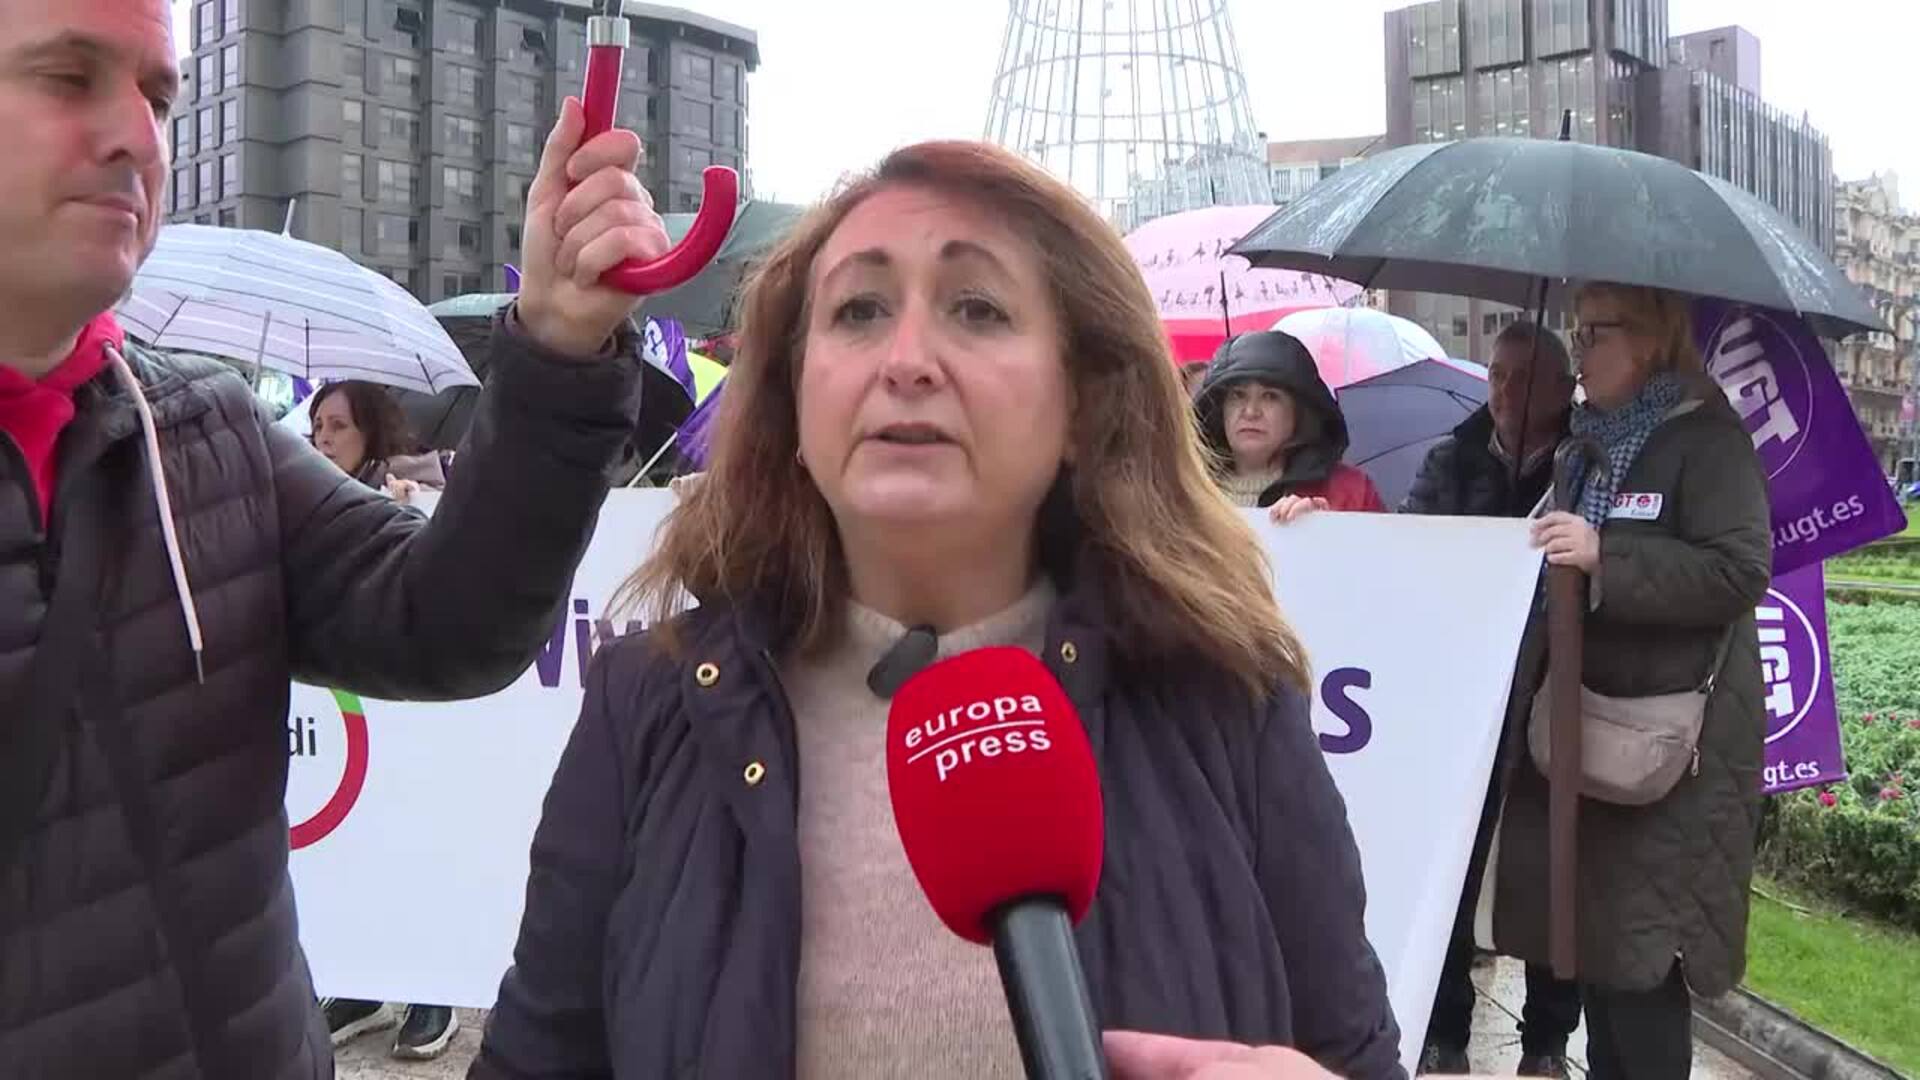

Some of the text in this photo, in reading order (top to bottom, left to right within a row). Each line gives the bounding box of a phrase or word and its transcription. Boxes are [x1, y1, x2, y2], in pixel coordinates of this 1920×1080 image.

[1707, 317, 1800, 451] UGT
[1770, 495, 1864, 549] .ugt.es
[905, 694, 1042, 748] europa
[936, 729, 1051, 782] press
